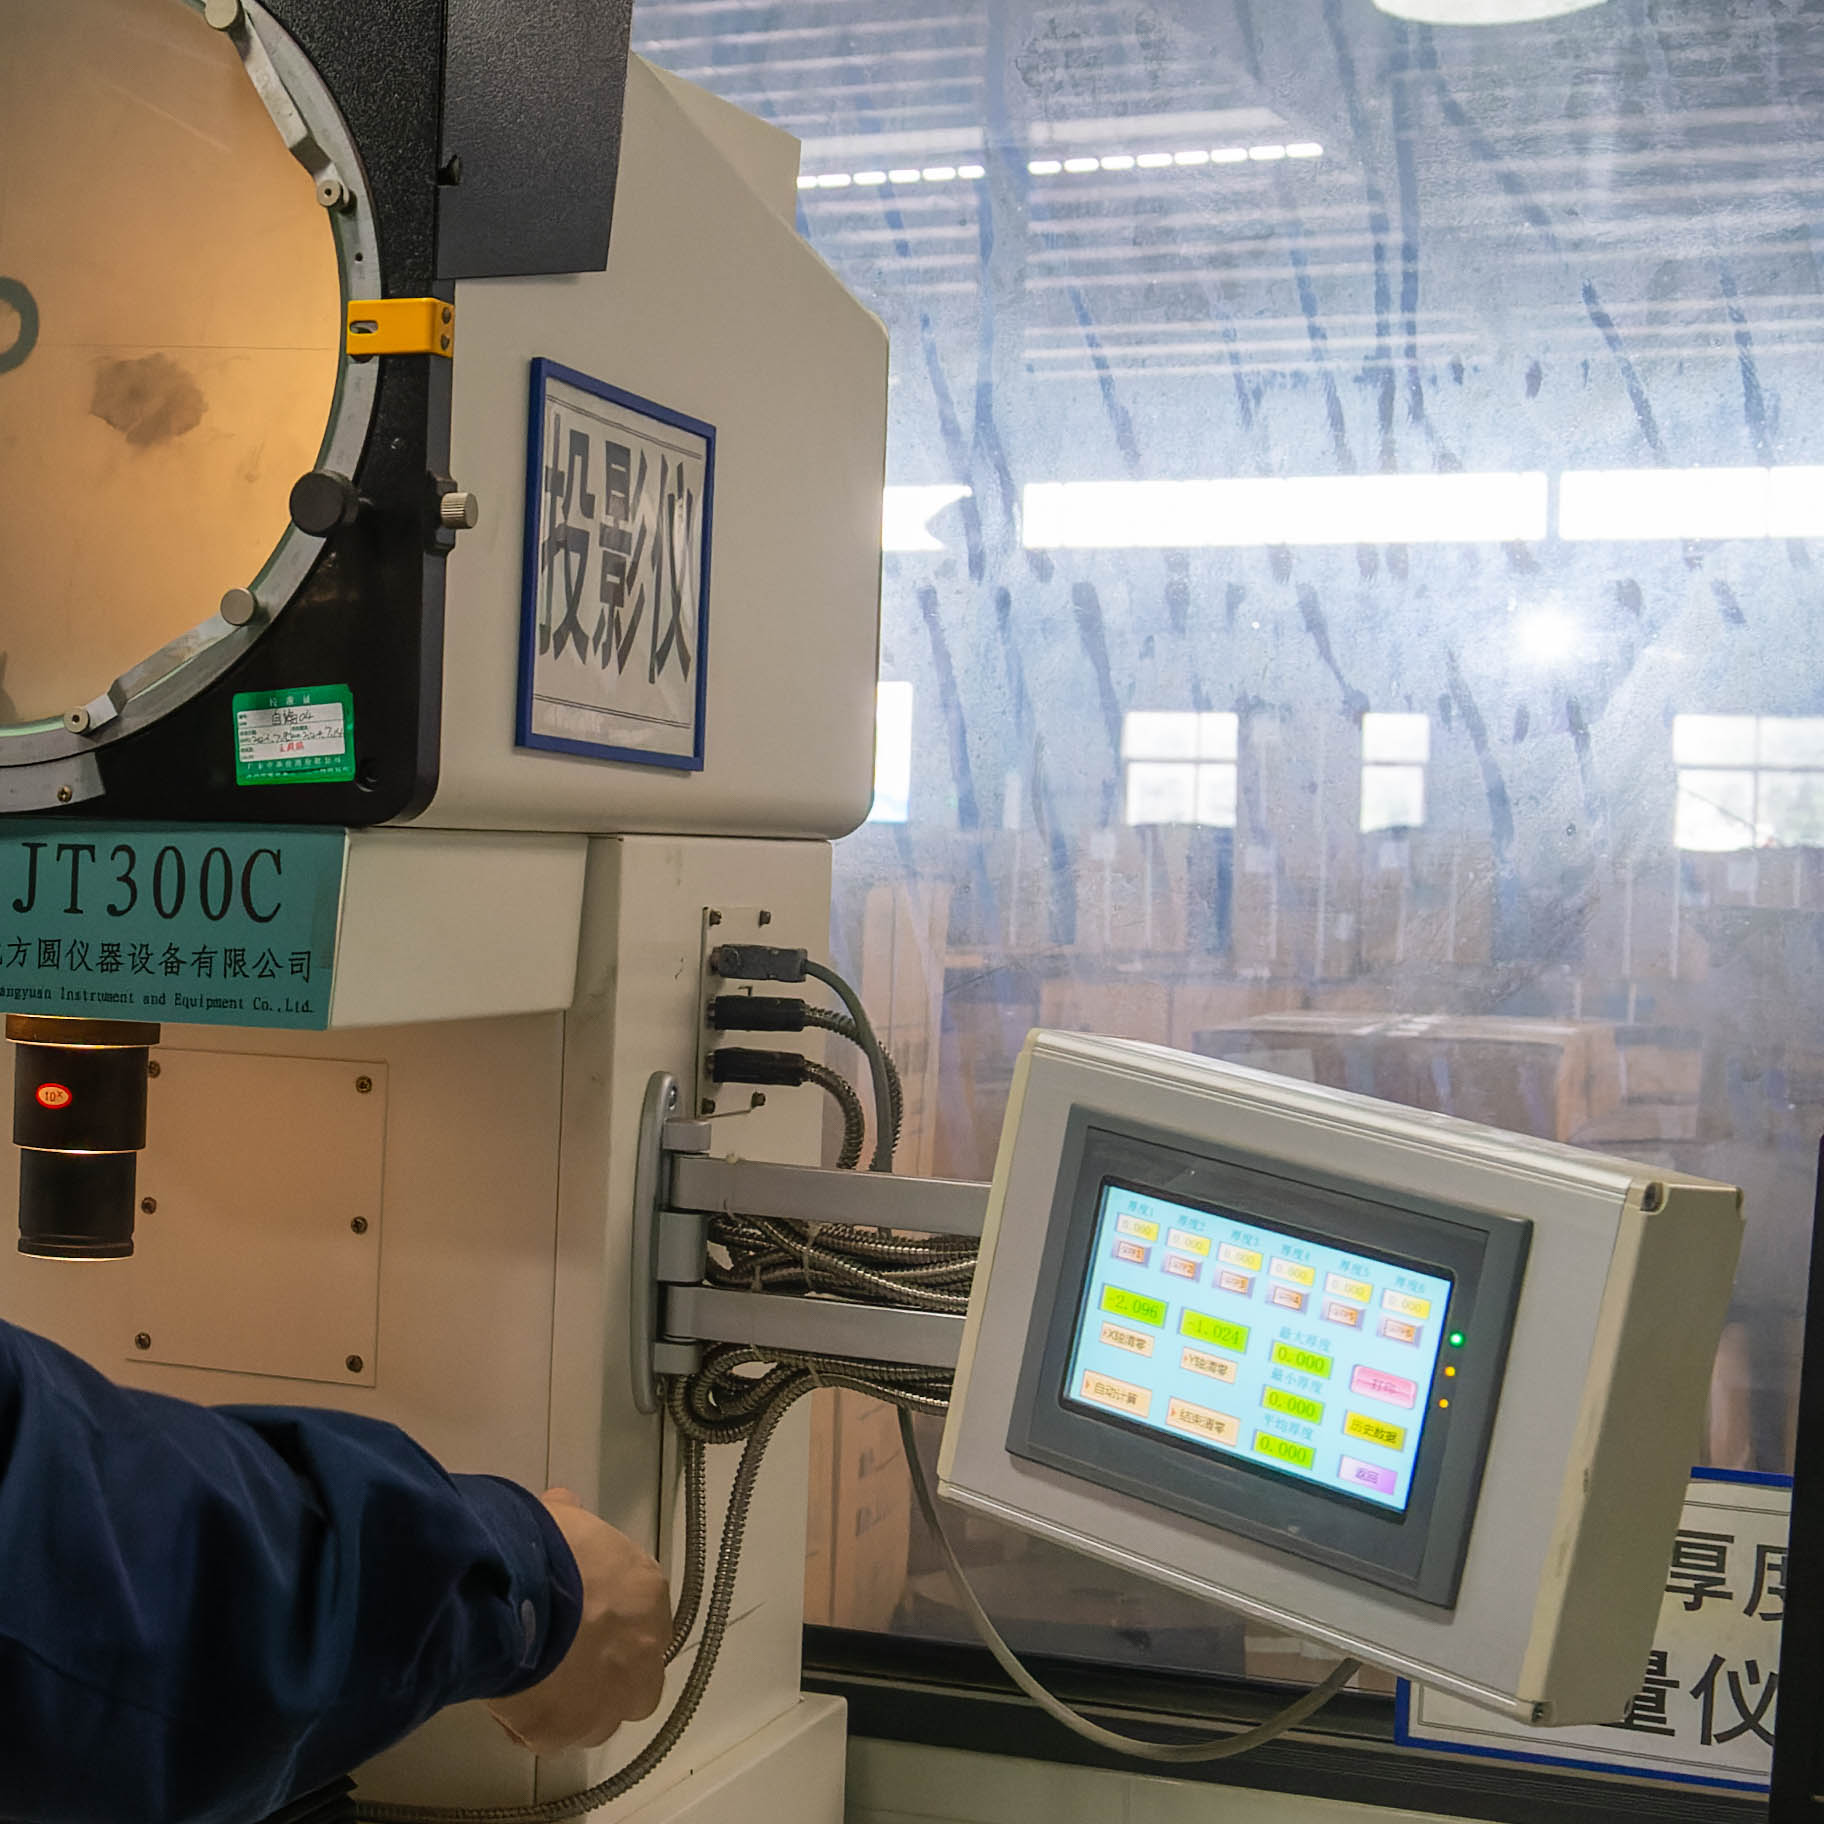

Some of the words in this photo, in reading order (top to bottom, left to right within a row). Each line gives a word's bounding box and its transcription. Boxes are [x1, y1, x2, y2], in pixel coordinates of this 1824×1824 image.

[539, 413, 694, 685] 投影仪
[12, 841, 283, 924] JT300C
[60, 986, 135, 1005] Instrument
[143, 992, 166, 1007] and
[174, 992, 245, 1011] Equipment
[1277, 1345, 1325, 1371] 0.000
[1093, 1381, 1138, 1407] 自动计算
[1268, 1389, 1316, 1416] 0.000
[1350, 1420, 1398, 1444] 历史数据
[1260, 1435, 1307, 1462] 0.000
